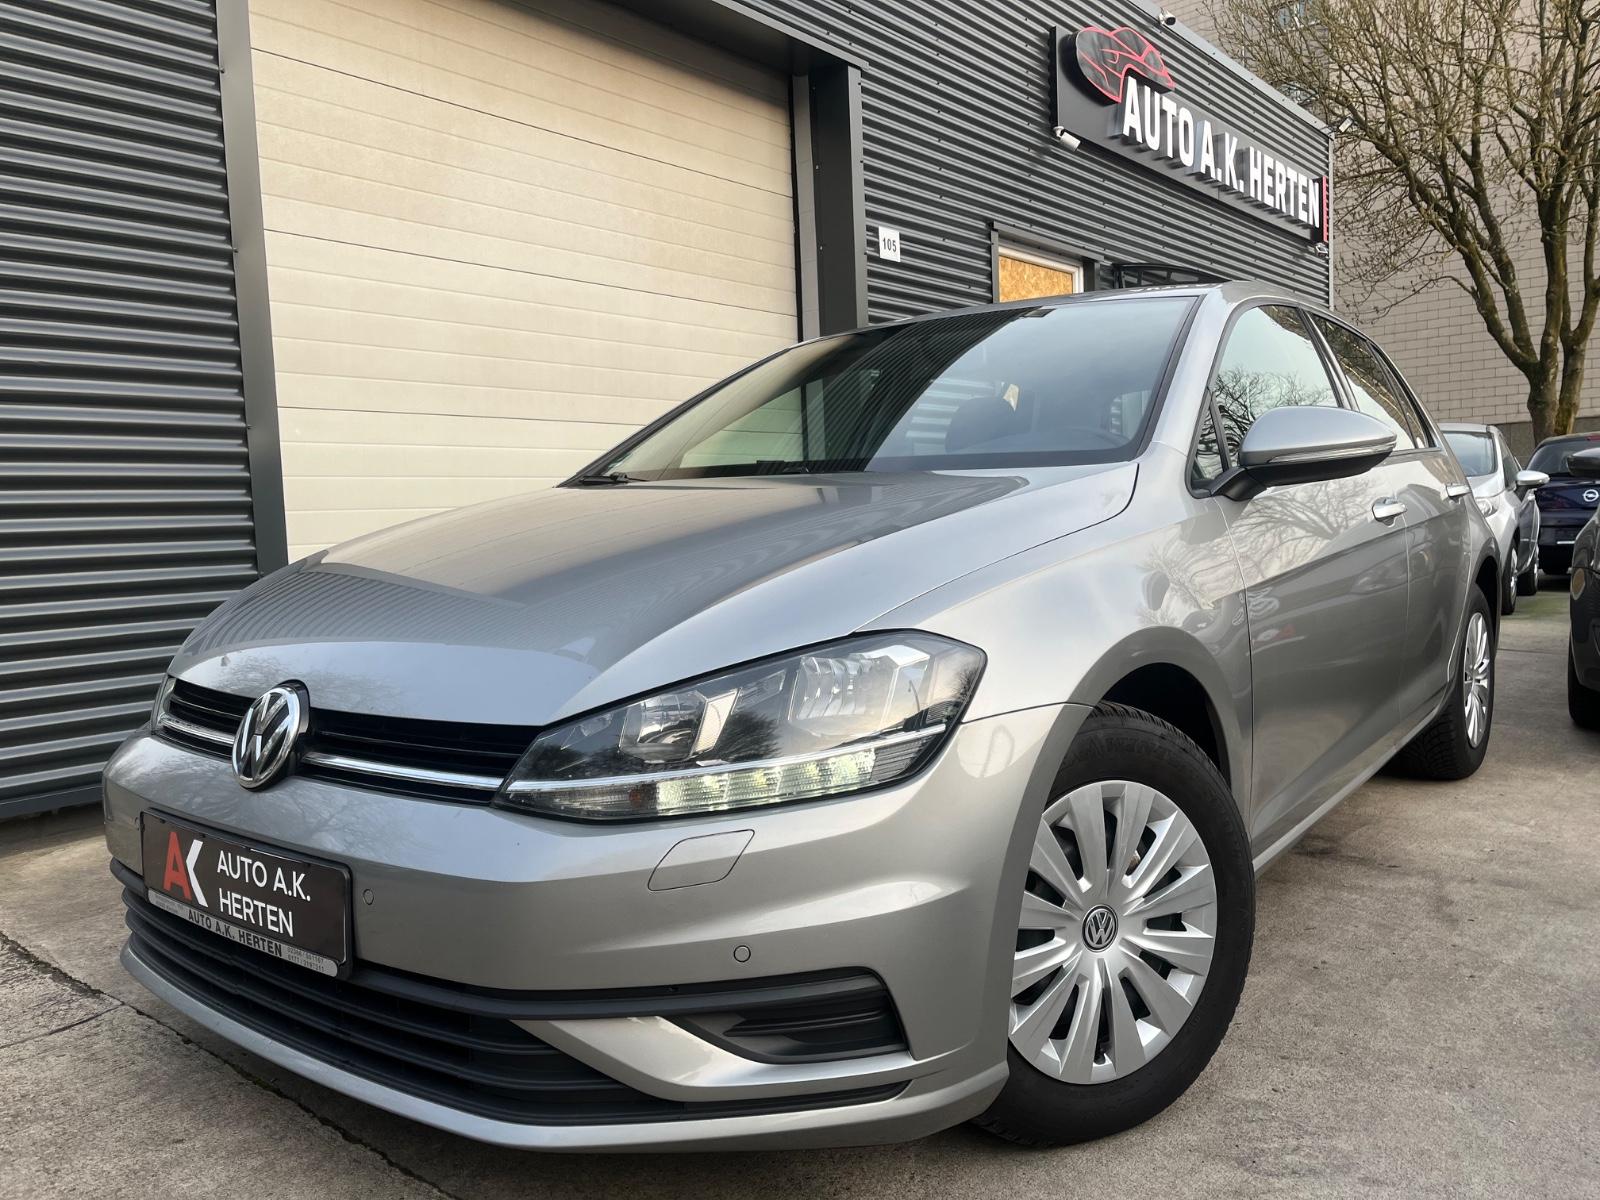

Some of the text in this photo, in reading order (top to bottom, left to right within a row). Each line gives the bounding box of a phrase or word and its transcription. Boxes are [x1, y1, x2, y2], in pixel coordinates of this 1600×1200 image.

[1123, 75, 1320, 228] AUTO A.K. HERTEN
[883, 237, 897, 253] 105
[217, 850, 311, 901] AUTO A.K.
[188, 909, 212, 931] AUTO
[215, 921, 235, 940] A.K.
[238, 931, 282, 958] HERTEN
[219, 888, 293, 937] HERTEN
